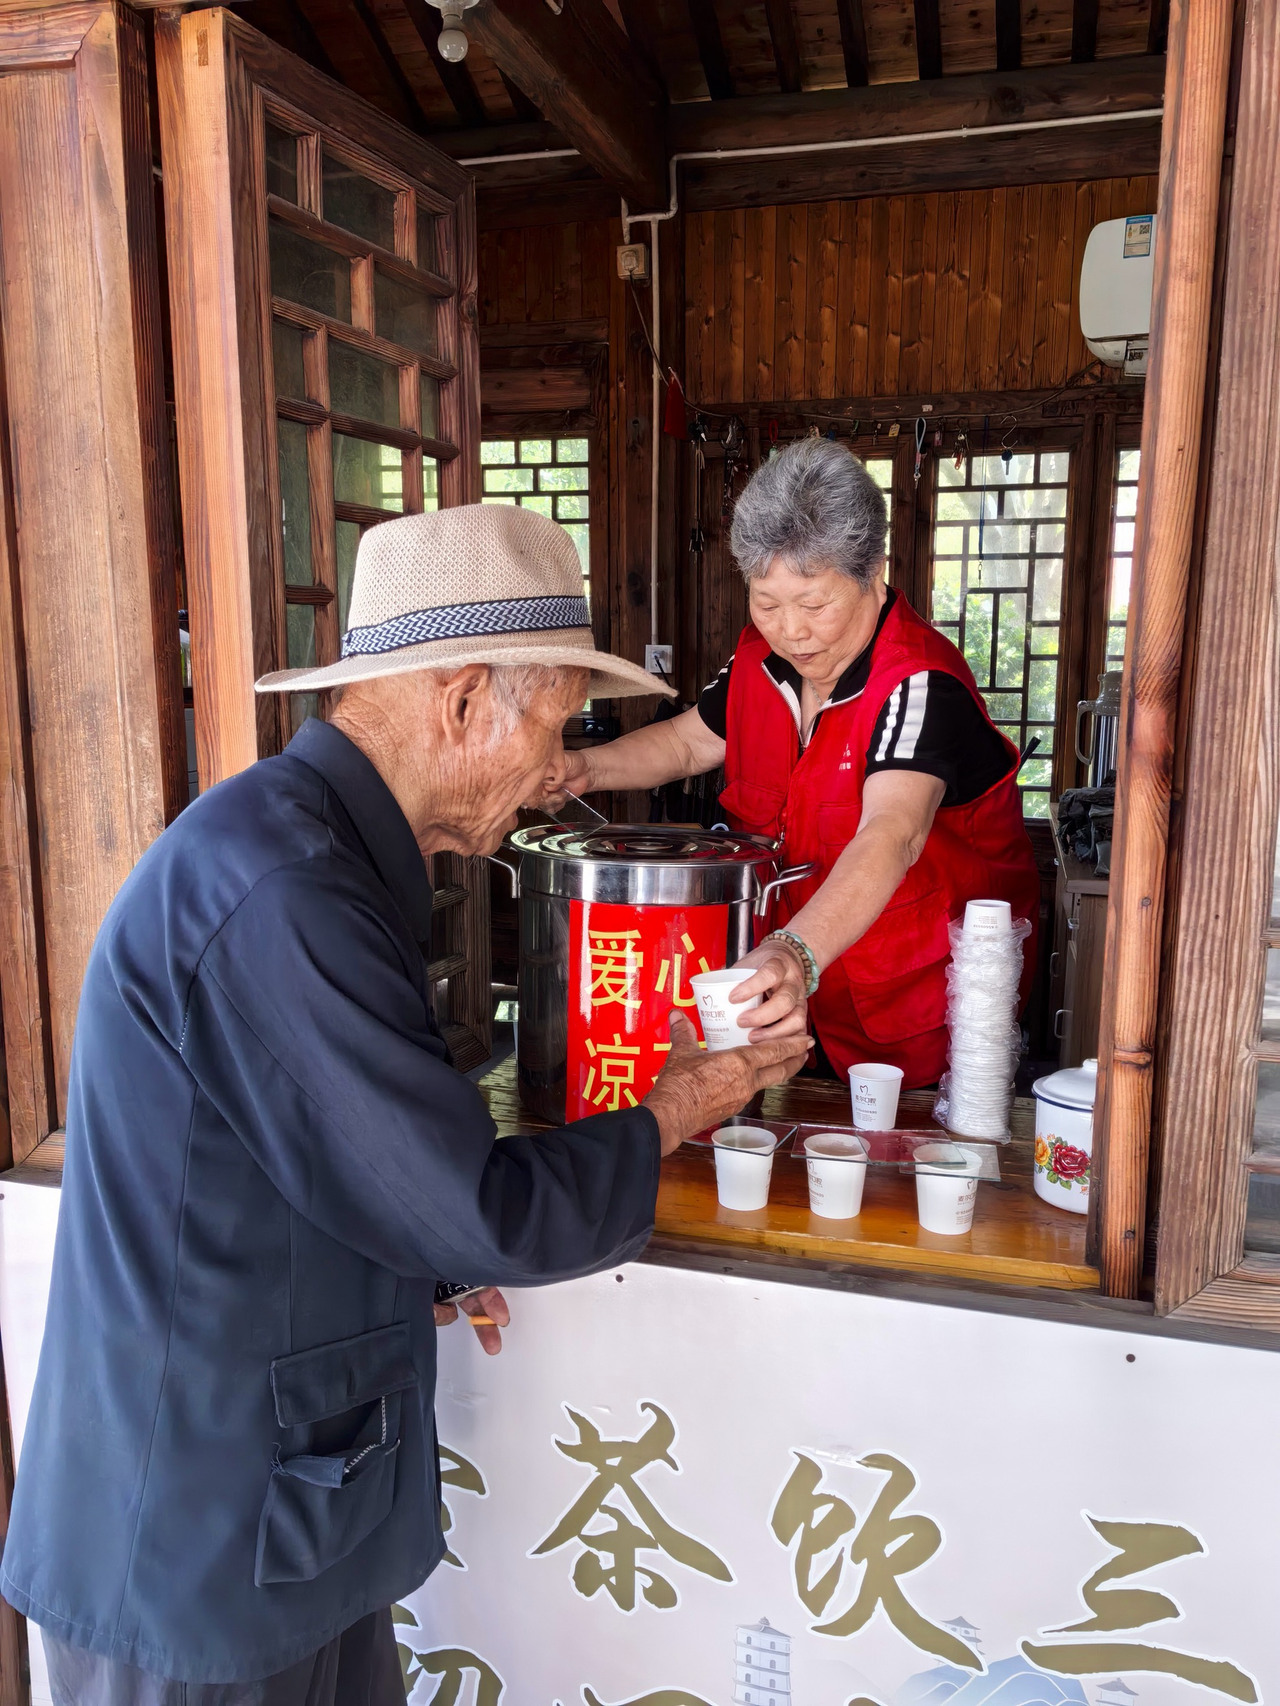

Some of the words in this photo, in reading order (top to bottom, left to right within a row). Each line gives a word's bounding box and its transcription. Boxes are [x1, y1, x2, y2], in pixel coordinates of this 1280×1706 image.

[585, 929, 711, 1009] 爱心
[582, 1033, 708, 1111] 凉
[437, 1398, 1262, 1704] 茶饮三
